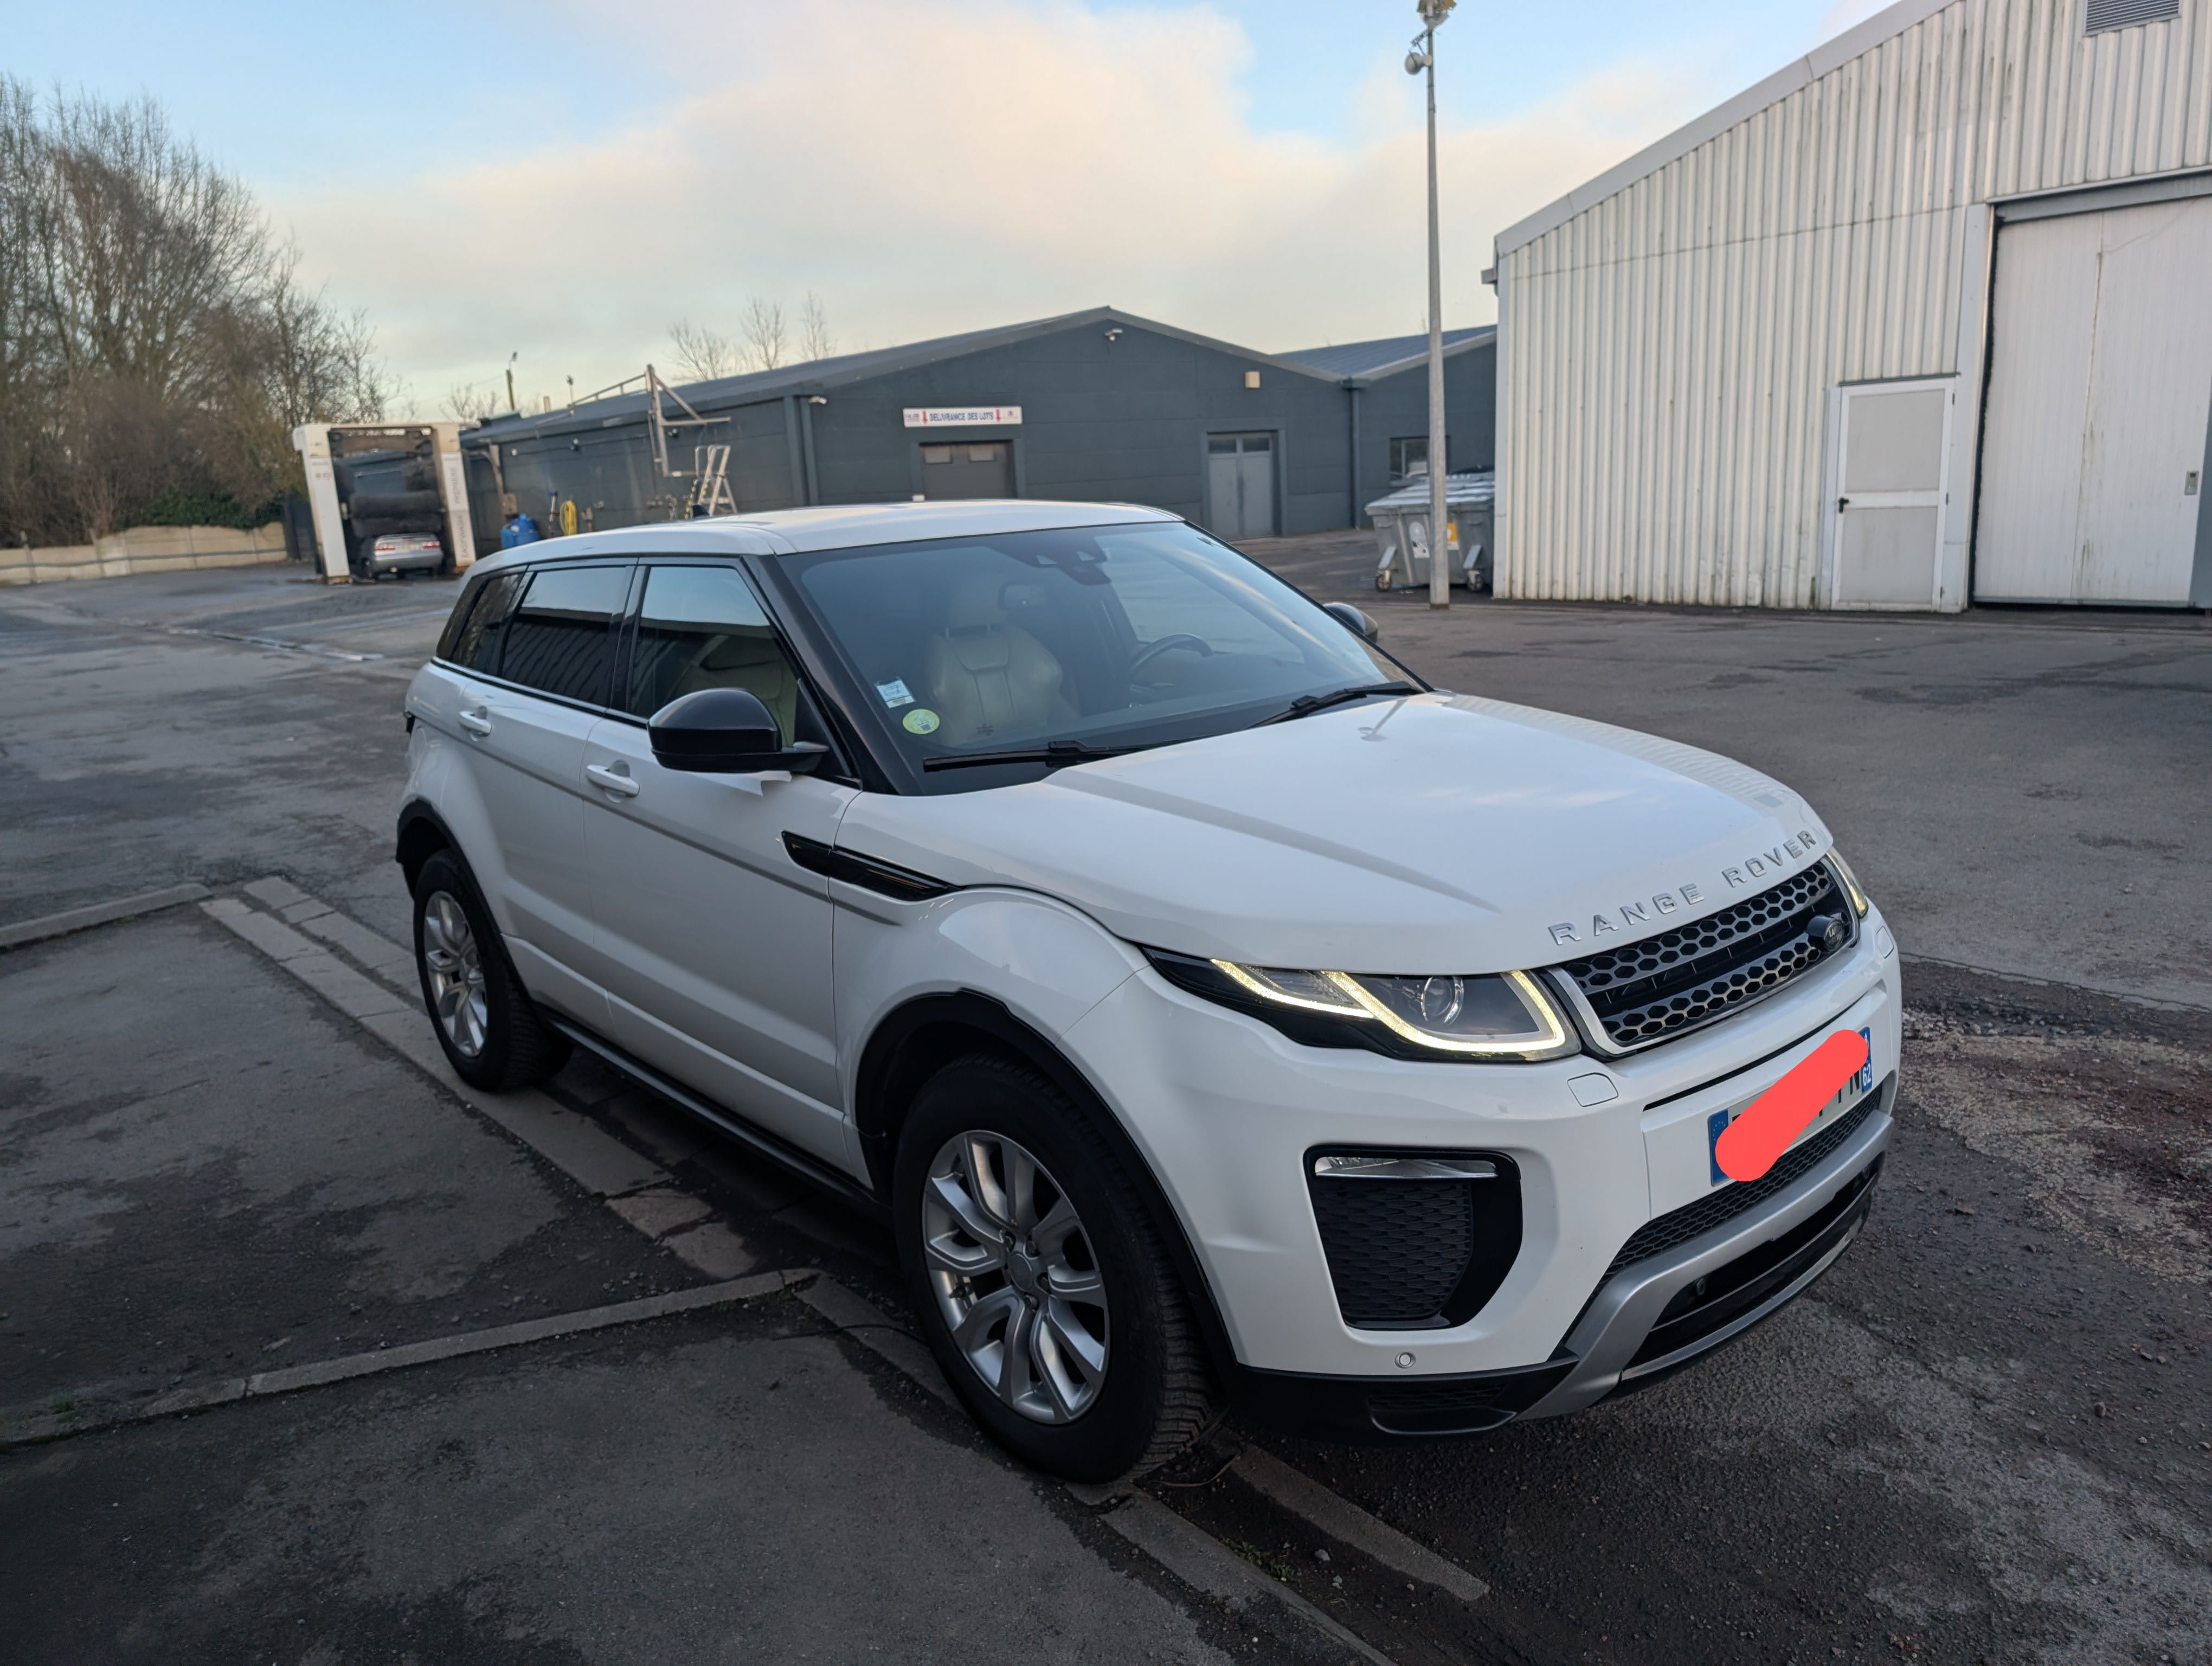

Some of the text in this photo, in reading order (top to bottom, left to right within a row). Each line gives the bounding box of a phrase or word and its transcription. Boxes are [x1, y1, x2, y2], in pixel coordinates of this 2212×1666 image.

[967, 412, 978, 421] DES
[1548, 830, 1816, 945] RANGE ROVER
[1862, 1063, 1872, 1087] 62
